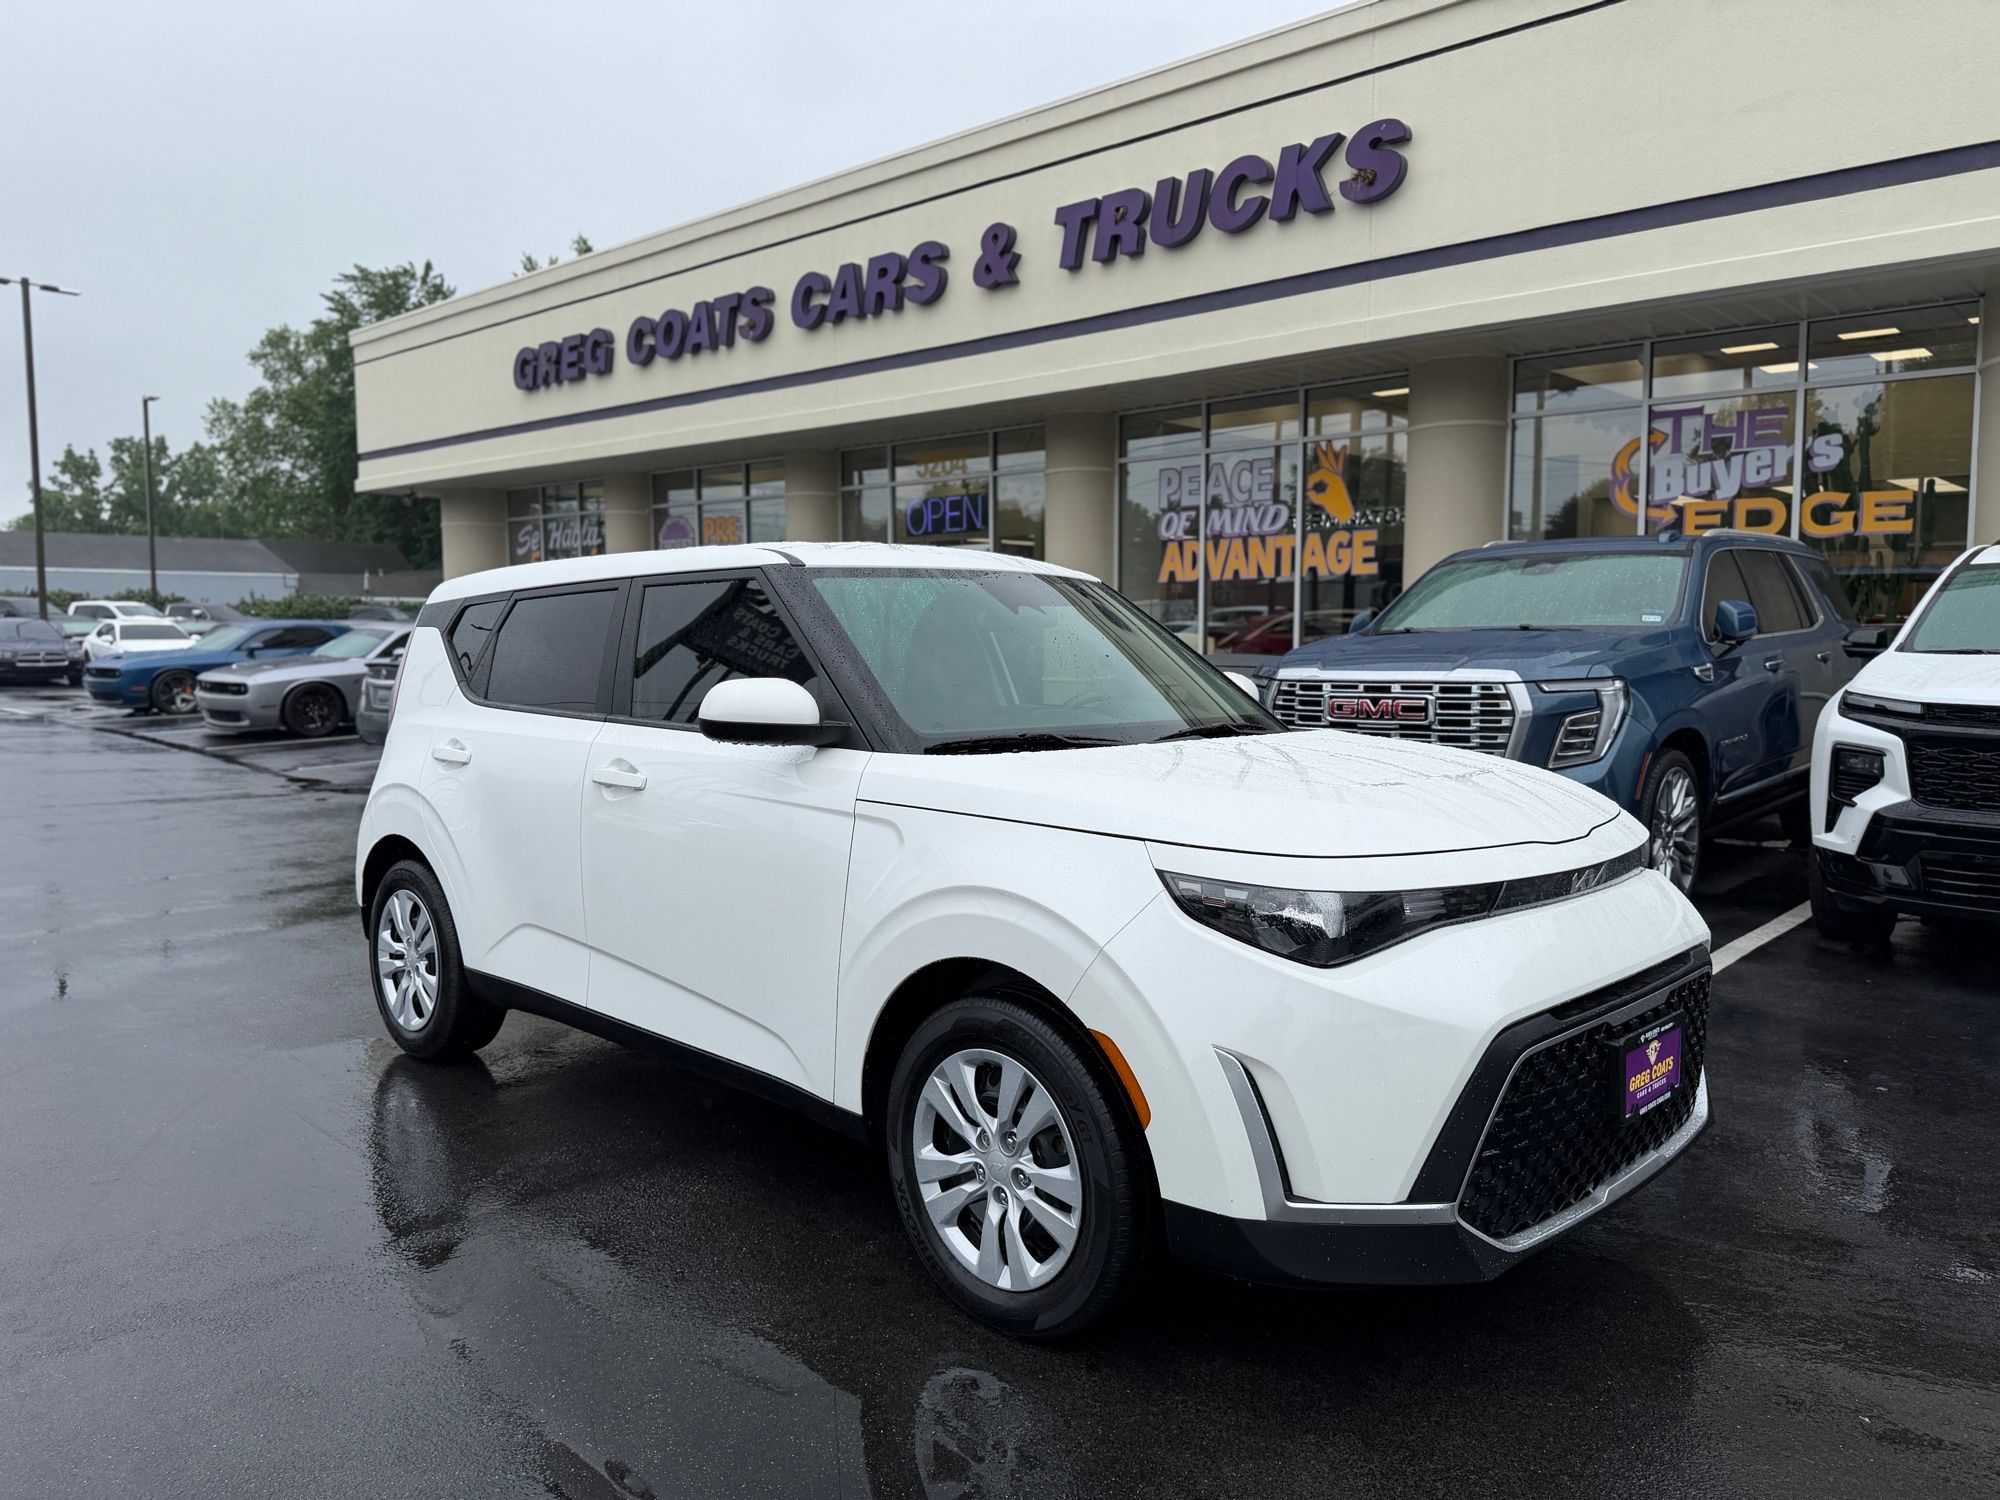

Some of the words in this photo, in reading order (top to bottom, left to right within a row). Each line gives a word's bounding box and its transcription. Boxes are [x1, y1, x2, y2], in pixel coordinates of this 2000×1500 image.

[514, 327, 614, 391] GREG
[626, 286, 775, 365] COATS
[791, 240, 949, 329] CARS
[973, 222, 1022, 289] &
[1054, 118, 1412, 271] TRUCKS
[1650, 406, 1789, 455] THE
[1158, 457, 1275, 508] PEACE
[1650, 433, 1845, 505] Buyer's
[907, 495, 982, 536] OPEN
[1158, 509, 1197, 540] OF
[1206, 504, 1290, 538] MIND
[1683, 489, 1914, 539] EDGE
[1157, 529, 1379, 583] ADVANTAGE
[1329, 698, 1426, 720] GMC
[1629, 1068, 1651, 1092] GREG
[1651, 1055, 1674, 1080] COATS
